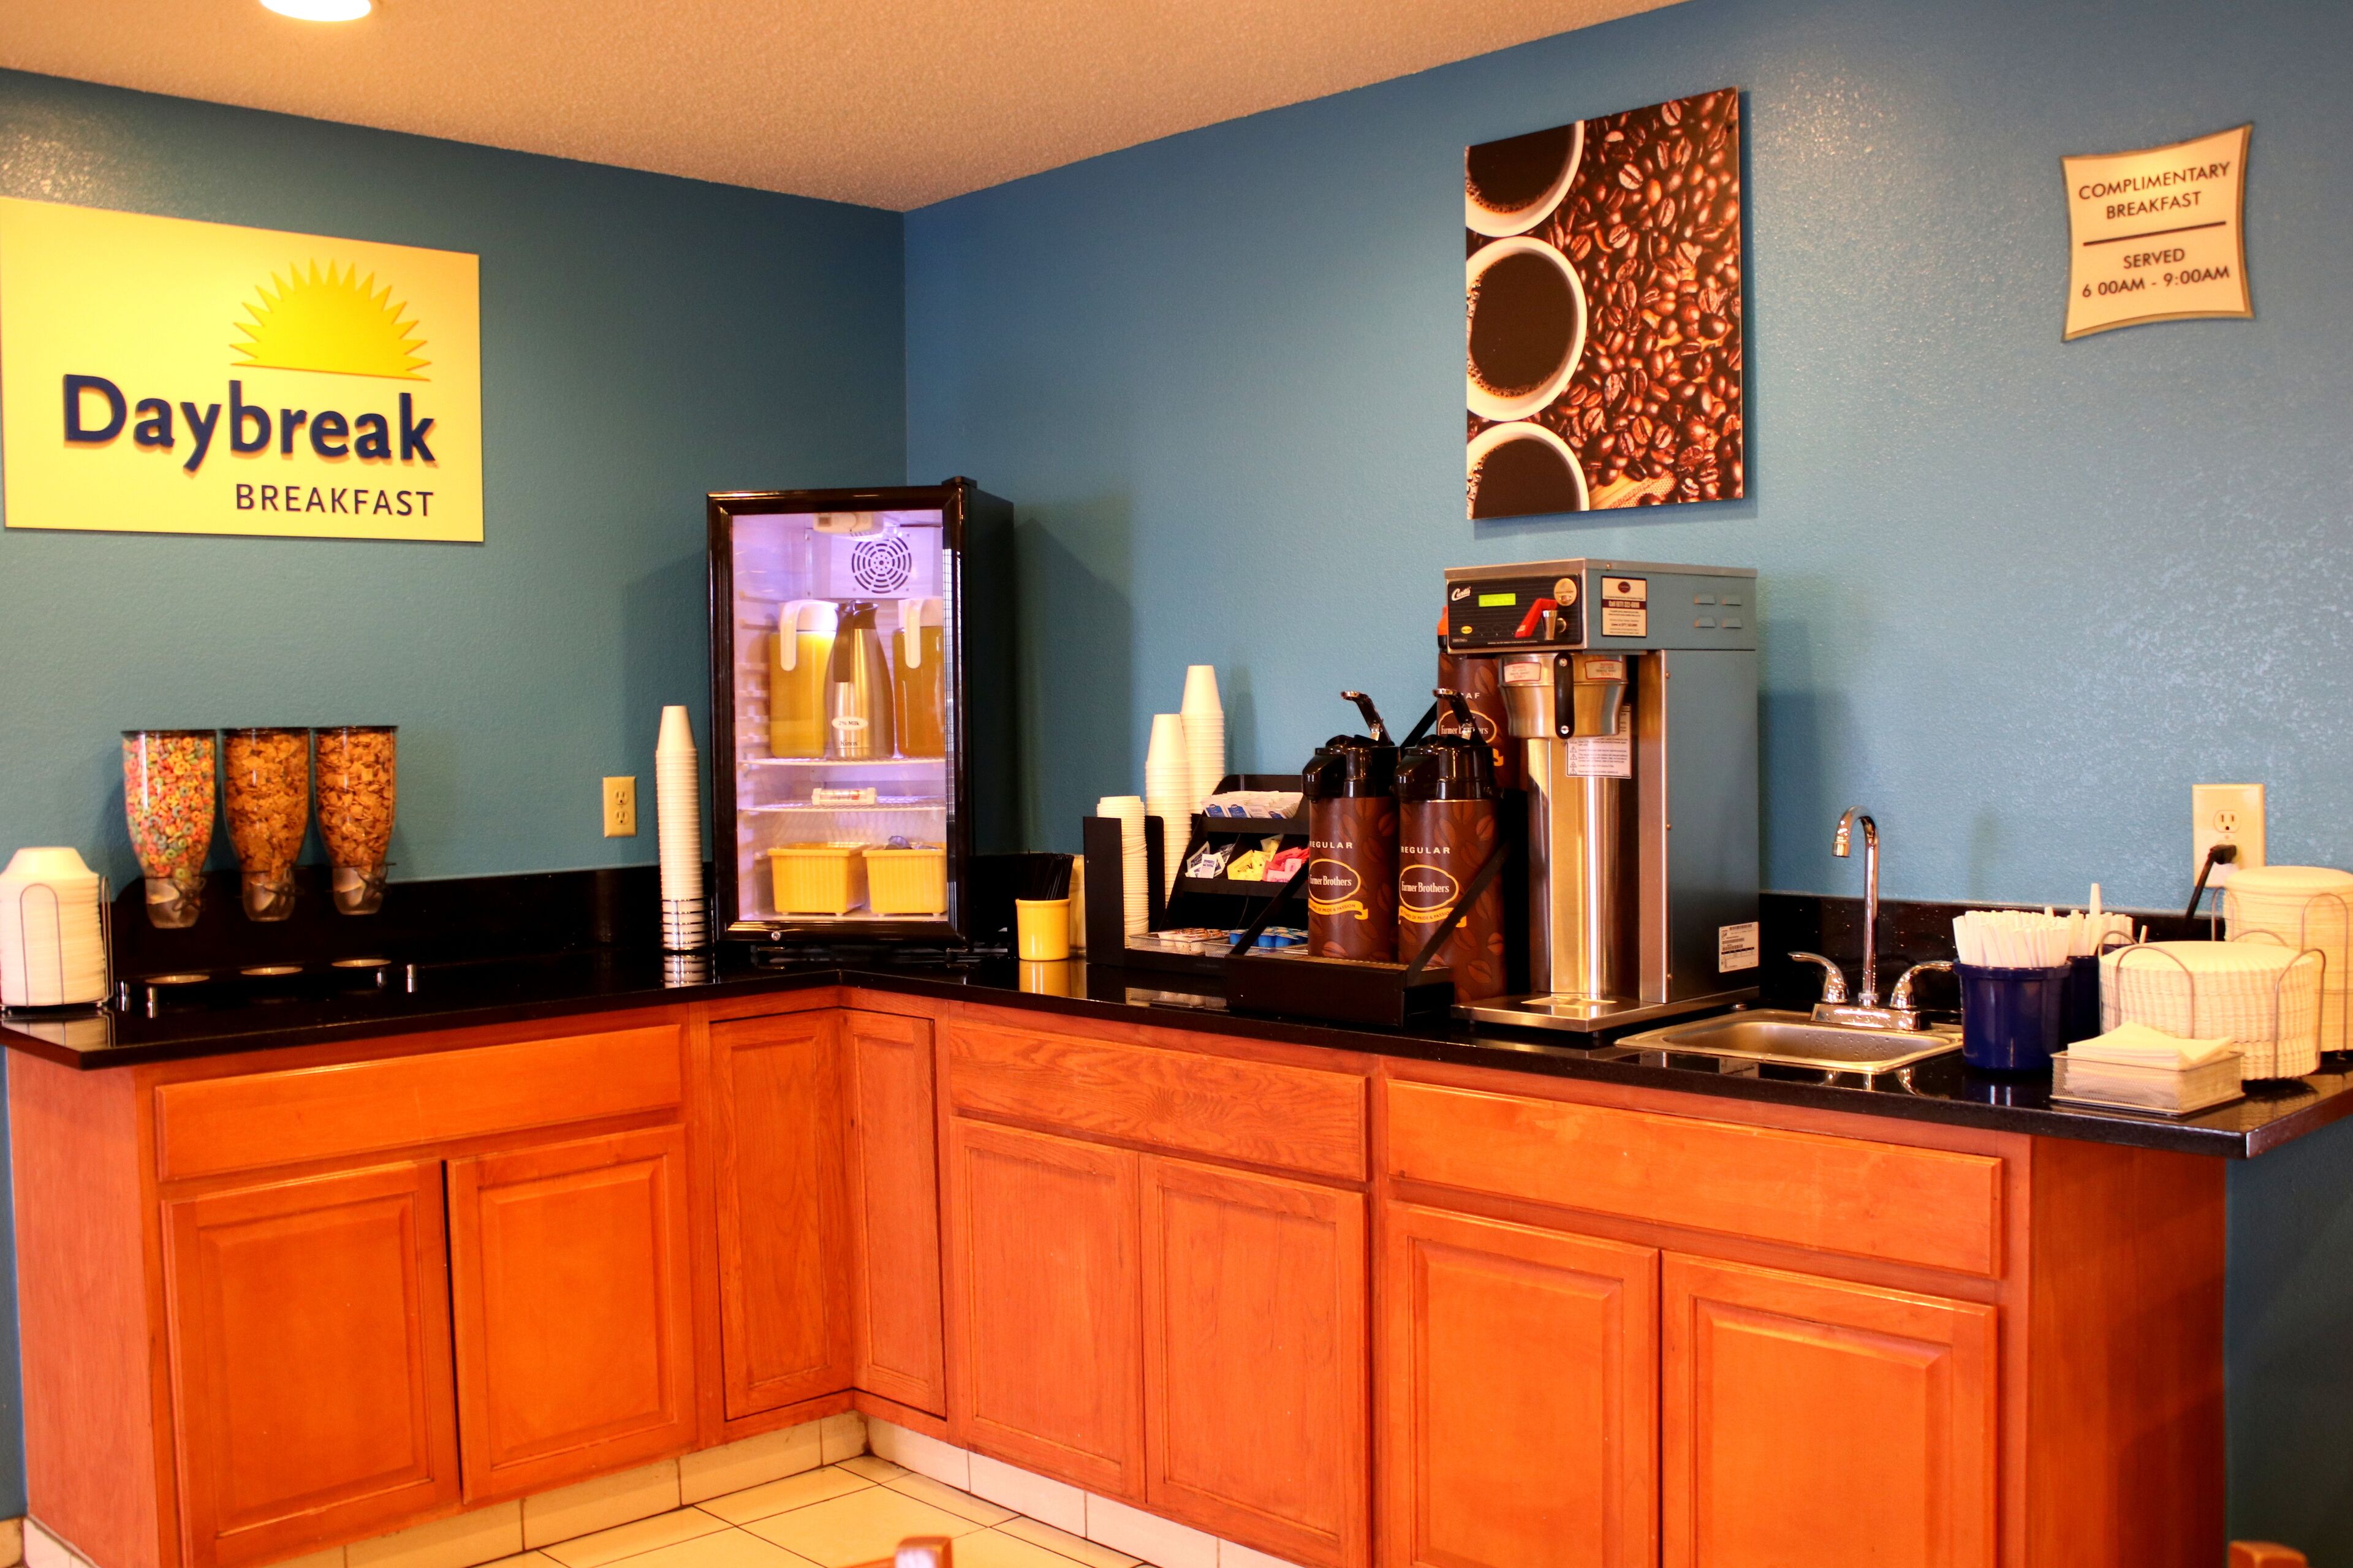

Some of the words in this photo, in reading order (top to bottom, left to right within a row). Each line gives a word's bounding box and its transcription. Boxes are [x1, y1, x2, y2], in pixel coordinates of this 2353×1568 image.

[2078, 162, 2230, 200] COMPLIMENTARY
[2106, 191, 2202, 219] BREAKFAST
[2123, 248, 2185, 269] SERVED
[2163, 265, 2230, 287] 9:00AM
[63, 374, 437, 472] Daybreak
[235, 483, 434, 517] BREAKFAST
[1323, 875, 1352, 886] Brothers
[1401, 881, 1417, 892] Farmer
[1418, 882, 1450, 893] Brothers
